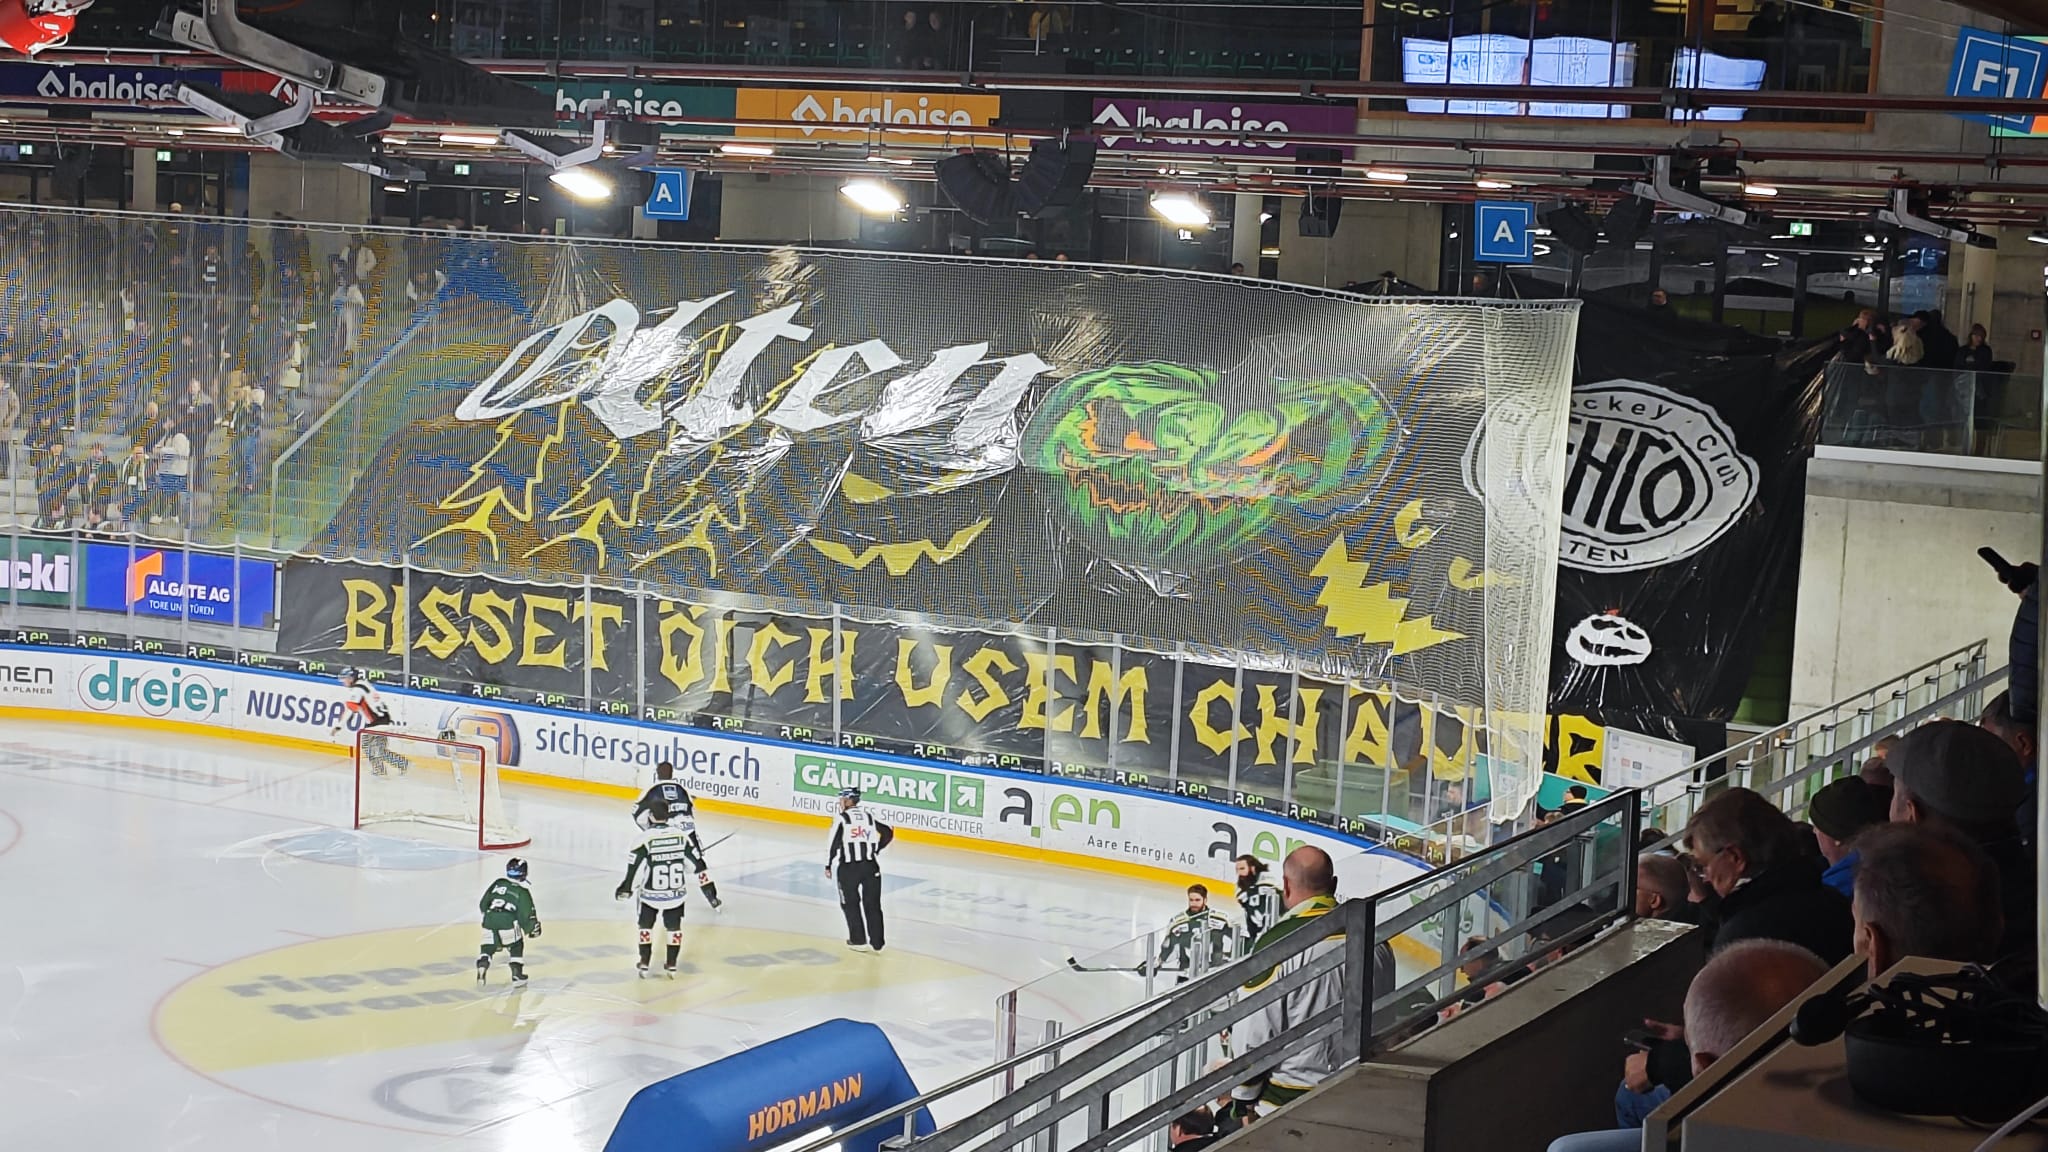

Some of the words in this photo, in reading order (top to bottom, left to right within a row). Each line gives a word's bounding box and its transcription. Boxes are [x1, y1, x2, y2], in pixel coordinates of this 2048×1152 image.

[1972, 59, 2019, 98] F1
[833, 96, 971, 134] baloise
[656, 182, 673, 203] A
[1492, 220, 1515, 243] A
[209, 587, 230, 602] AG
[338, 579, 623, 673] BISSET
[895, 636, 1151, 745] USEM
[89, 660, 228, 714] dreier
[535, 722, 760, 781] sichersauber.ch
[743, 786, 760, 799] AG
[801, 761, 938, 802] GÄUPARK
[792, 796, 821, 811] MEIN
[880, 808, 984, 835] SHOPPINGCENTER
[850, 825, 871, 841] sky
[1087, 835, 1118, 850] Aare
[1124, 841, 1173, 861] Energie
[1179, 853, 1195, 865] AG
[652, 862, 684, 890] 66
[747, 1072, 863, 1142] HÖRMANN
